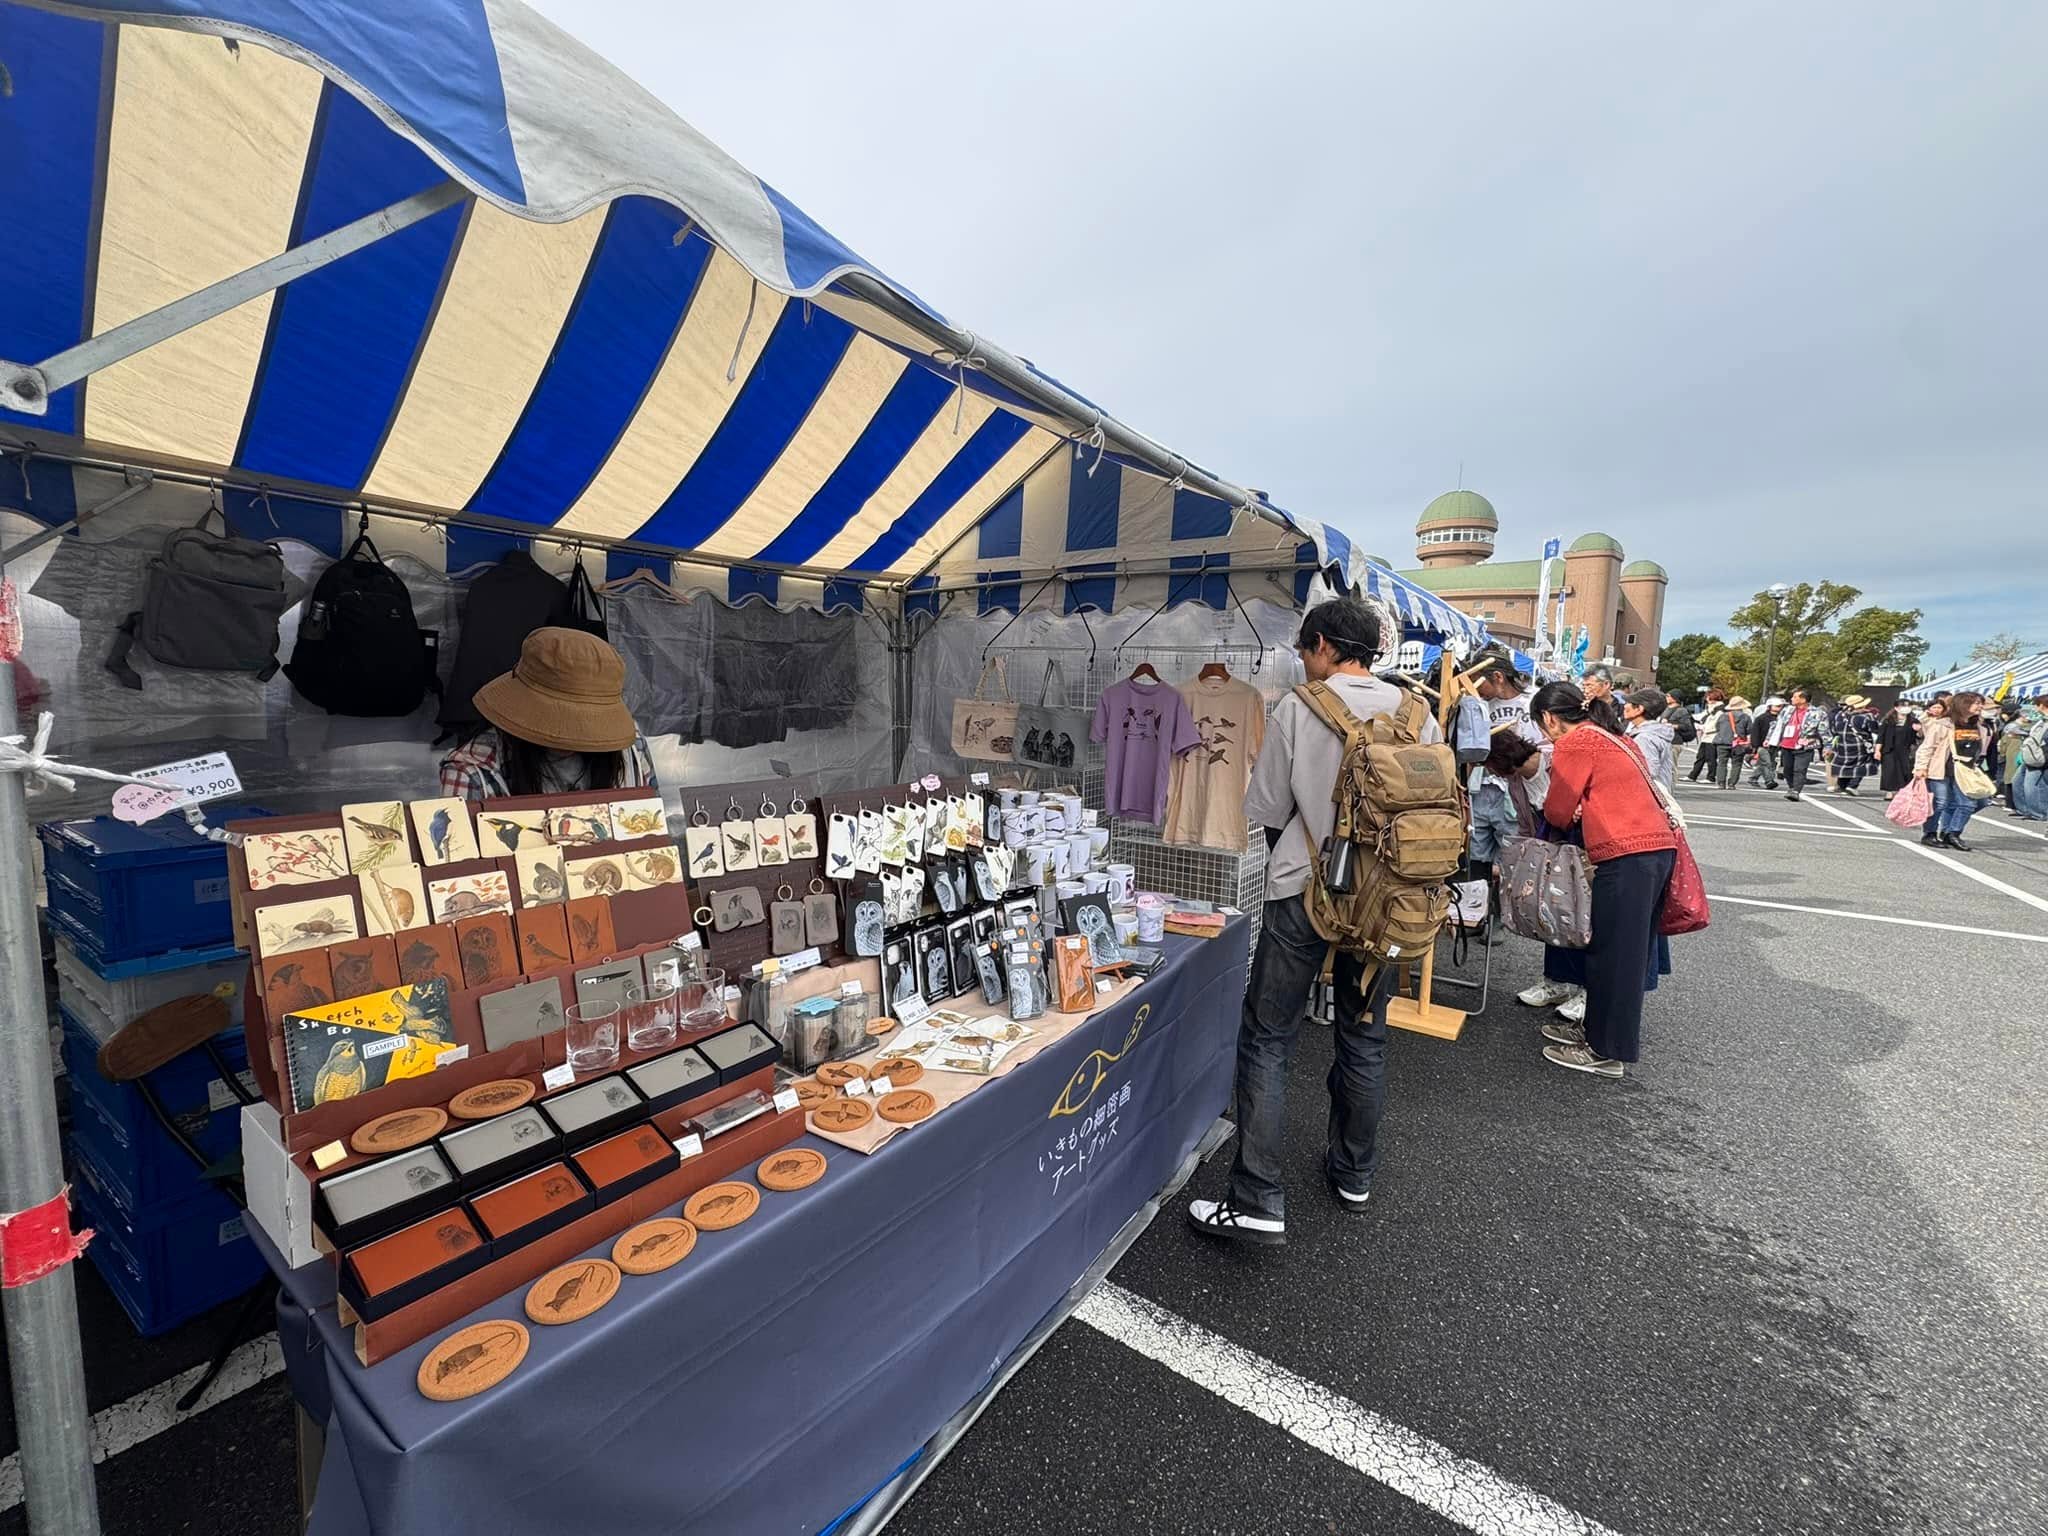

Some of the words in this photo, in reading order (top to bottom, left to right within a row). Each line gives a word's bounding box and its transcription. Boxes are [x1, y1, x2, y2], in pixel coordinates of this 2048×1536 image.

[160, 763, 193, 775] パスケース
[186, 778, 235, 796] ¥3,900
[368, 1040, 402, 1055] SAMPLE
[1039, 1080, 1131, 1172] いきもの細密画
[1052, 1116, 1120, 1196] アートグッズ
